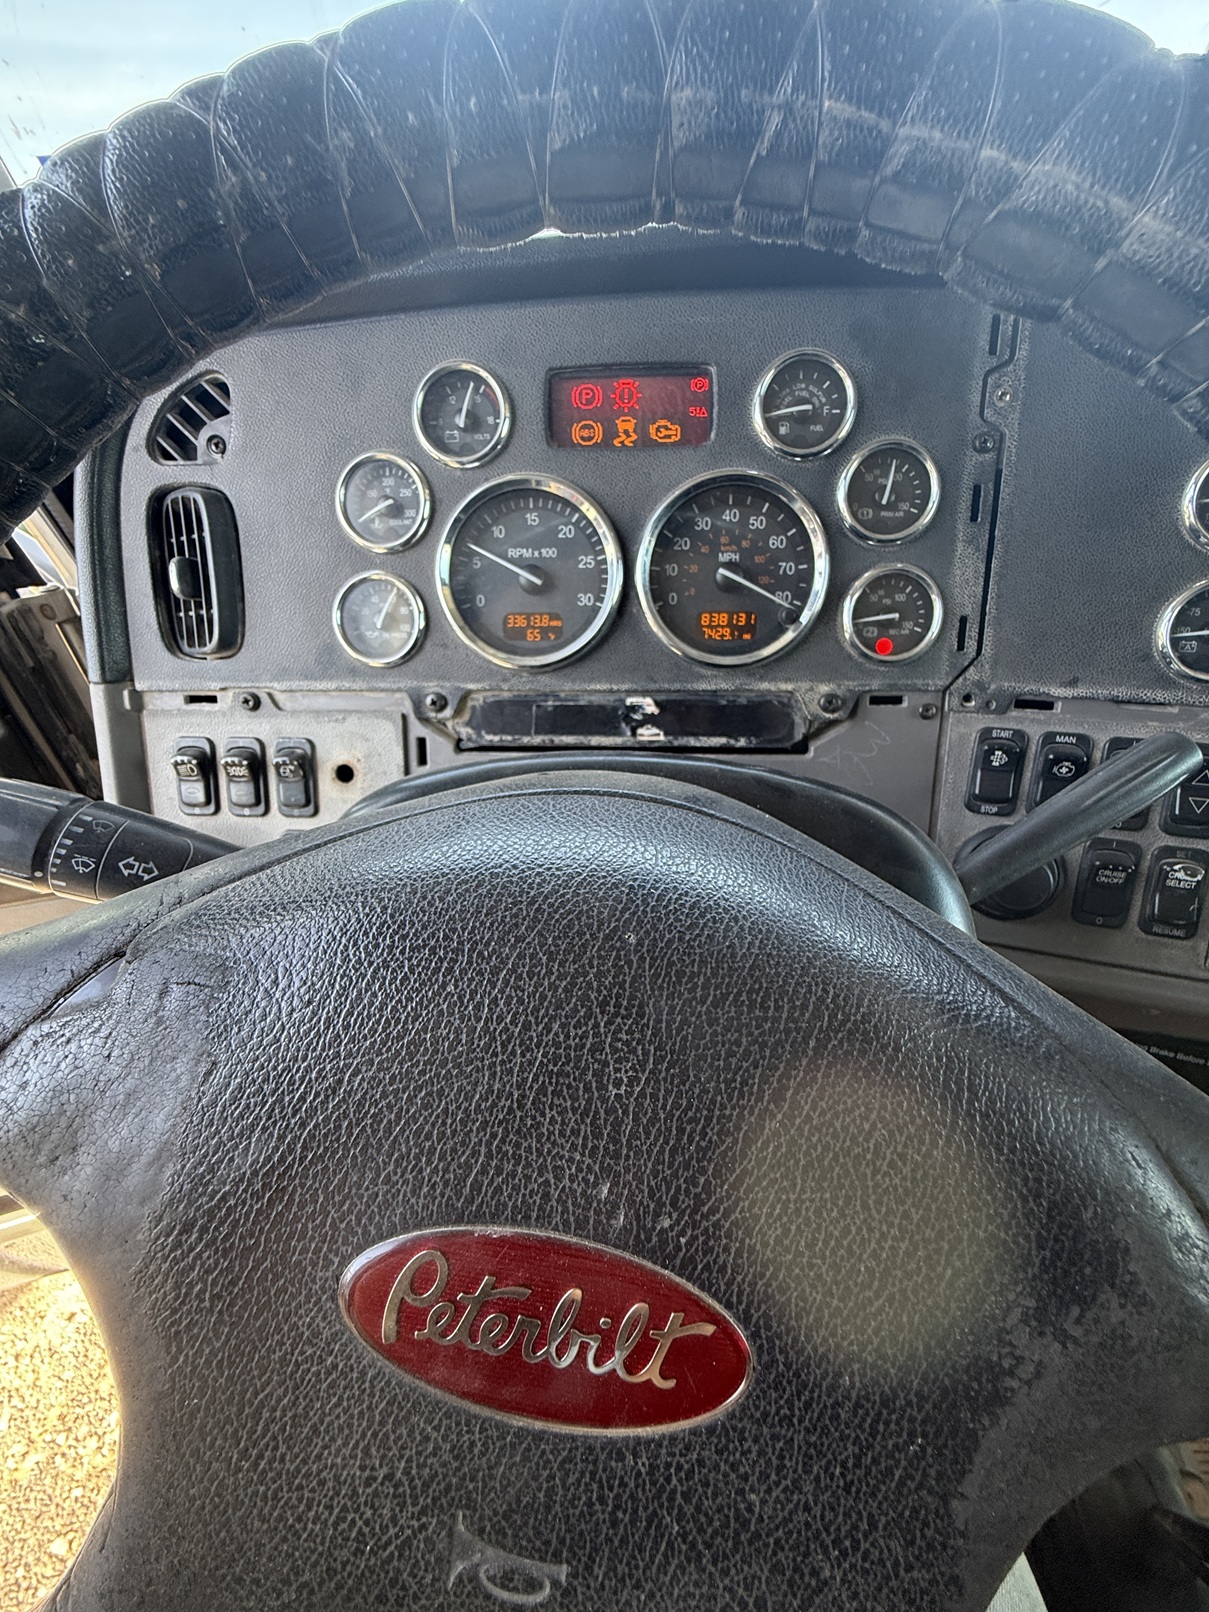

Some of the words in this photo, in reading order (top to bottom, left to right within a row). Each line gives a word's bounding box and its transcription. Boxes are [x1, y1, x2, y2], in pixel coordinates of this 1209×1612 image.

[823, 406, 830, 416] F
[382, 478, 395, 486] 200
[399, 489, 413, 497] 250
[897, 502, 910, 511] 150
[404, 509, 417, 517] 300
[525, 512, 539, 526] 15
[722, 509, 740, 522] 40
[694, 517, 711, 530] 30
[749, 516, 766, 530] 50
[492, 525, 505, 539] 10
[557, 525, 574, 538] 20
[674, 537, 690, 550] 20
[769, 536, 787, 549] 60
[507, 548, 532, 558] RPM
[541, 548, 557, 558] 100
[718, 552, 740, 563] MPH
[472, 557, 481, 569] 5
[578, 556, 595, 569] 25
[778, 562, 796, 575] 70
[665, 564, 678, 576] 10
[476, 595, 486, 607] 0
[577, 594, 594, 606] 30
[668, 593, 678, 605] 0
[775, 591, 792, 605] 80
[507, 614, 549, 627] 33613.8
[701, 613, 756, 626] 838131
[526, 629, 541, 641] 65
[991, 729, 1014, 739] START
[1055, 735, 1077, 744] MAN
[980, 806, 998, 815] STOP
[1098, 869, 1127, 879] CRUISE
[1165, 878, 1197, 890] SELECT
[1152, 925, 1187, 938] RESUME
[381, 1250, 717, 1390] Peterbilt
